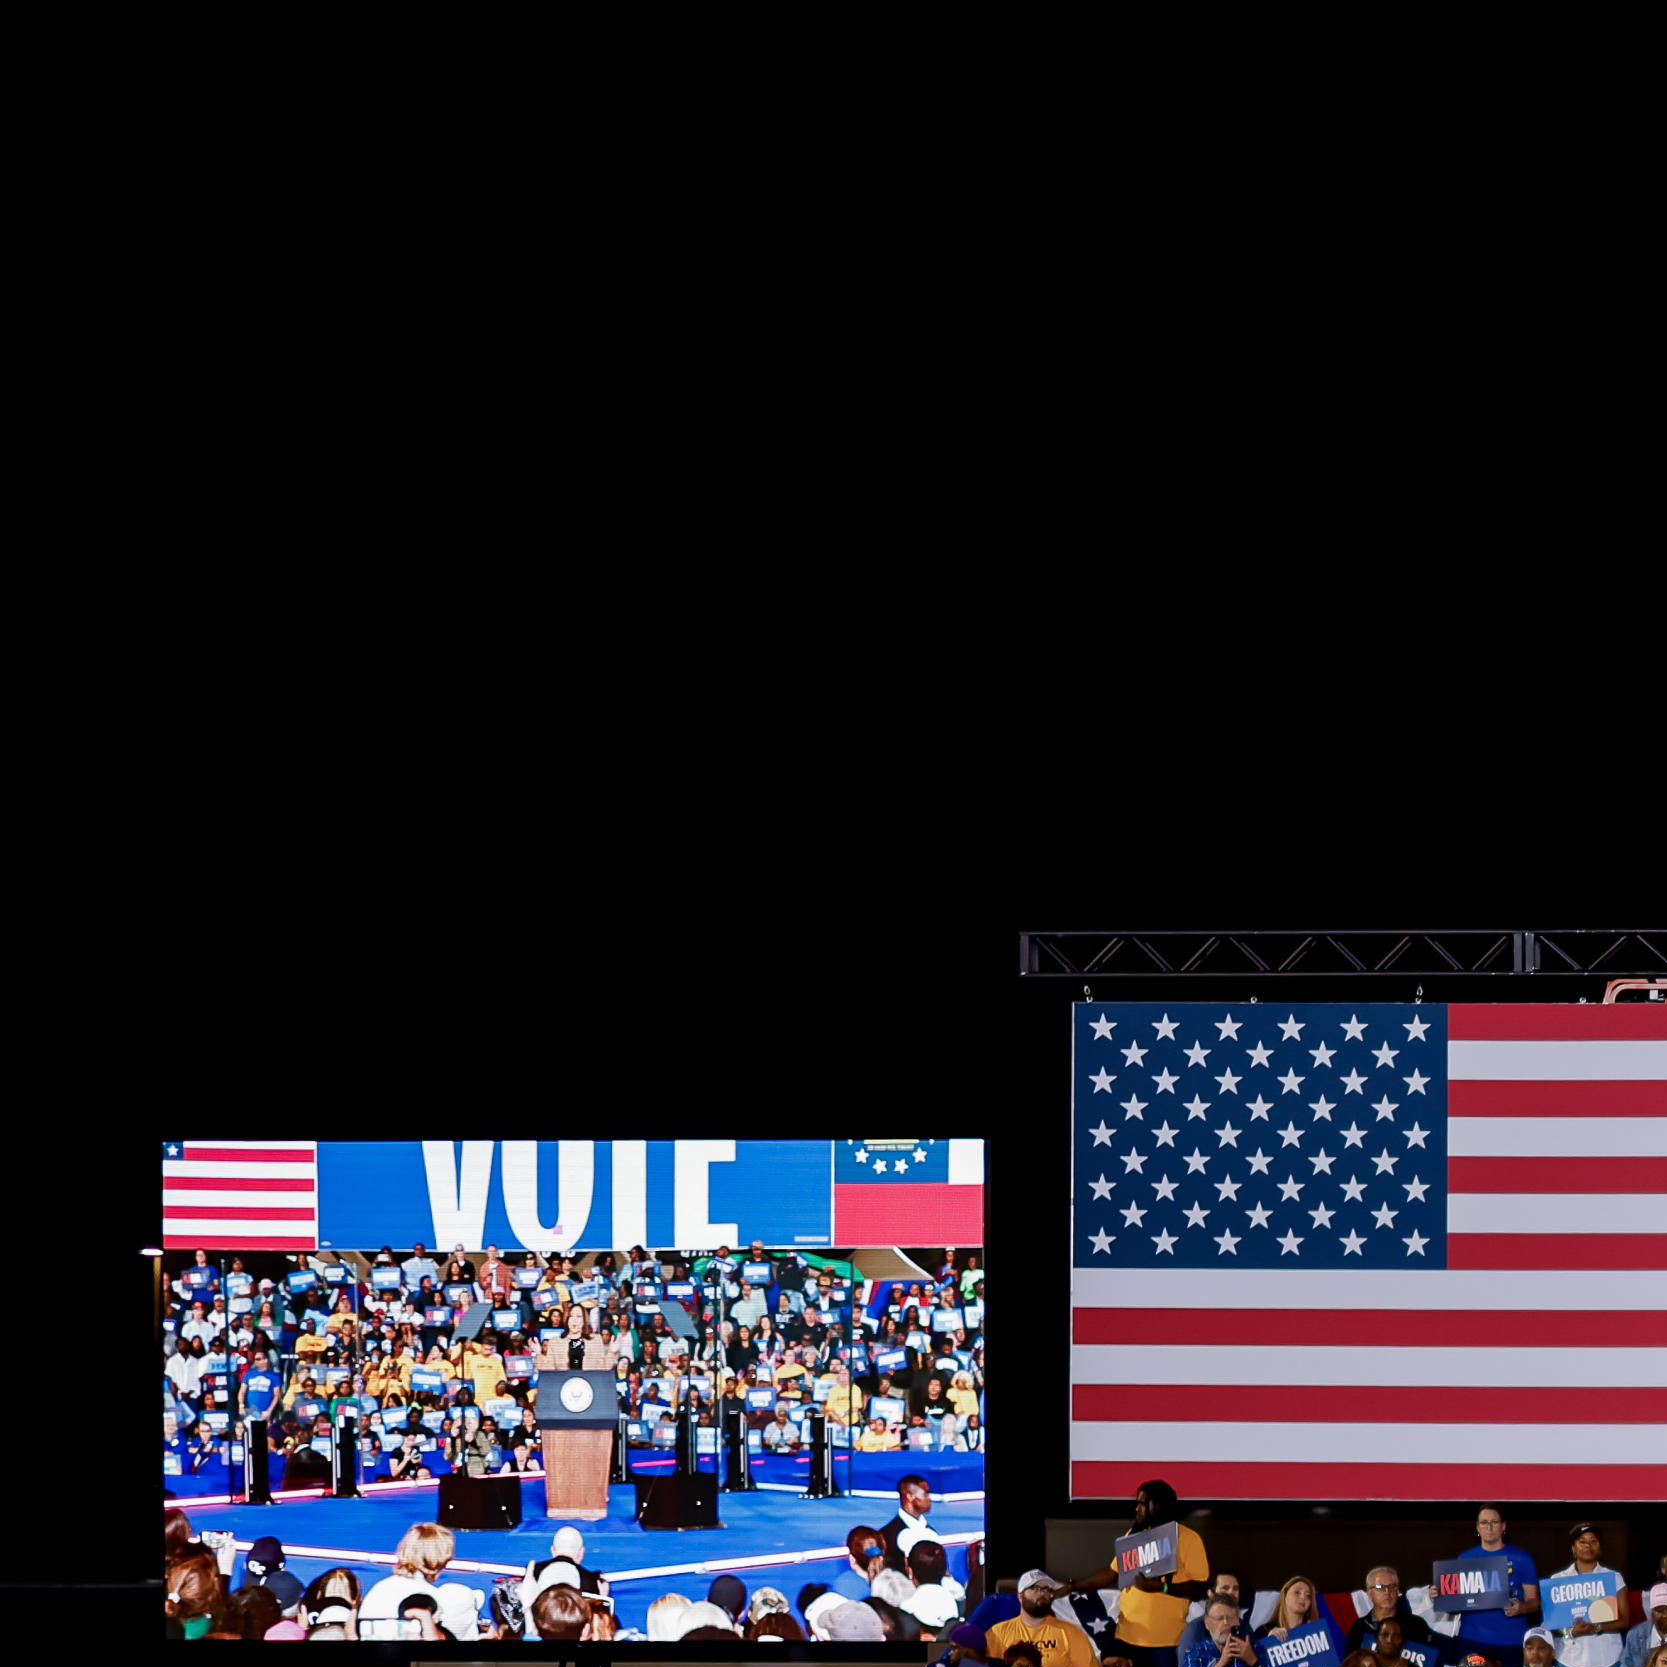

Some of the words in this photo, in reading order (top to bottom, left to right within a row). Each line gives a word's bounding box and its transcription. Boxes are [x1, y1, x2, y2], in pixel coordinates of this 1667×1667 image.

[1122, 1537, 1172, 1572] KAMALA
[1440, 1572, 1500, 1594] KAMALA
[1551, 1581, 1606, 1603] GEORGIA
[1267, 1632, 1330, 1667] FREEDOM
